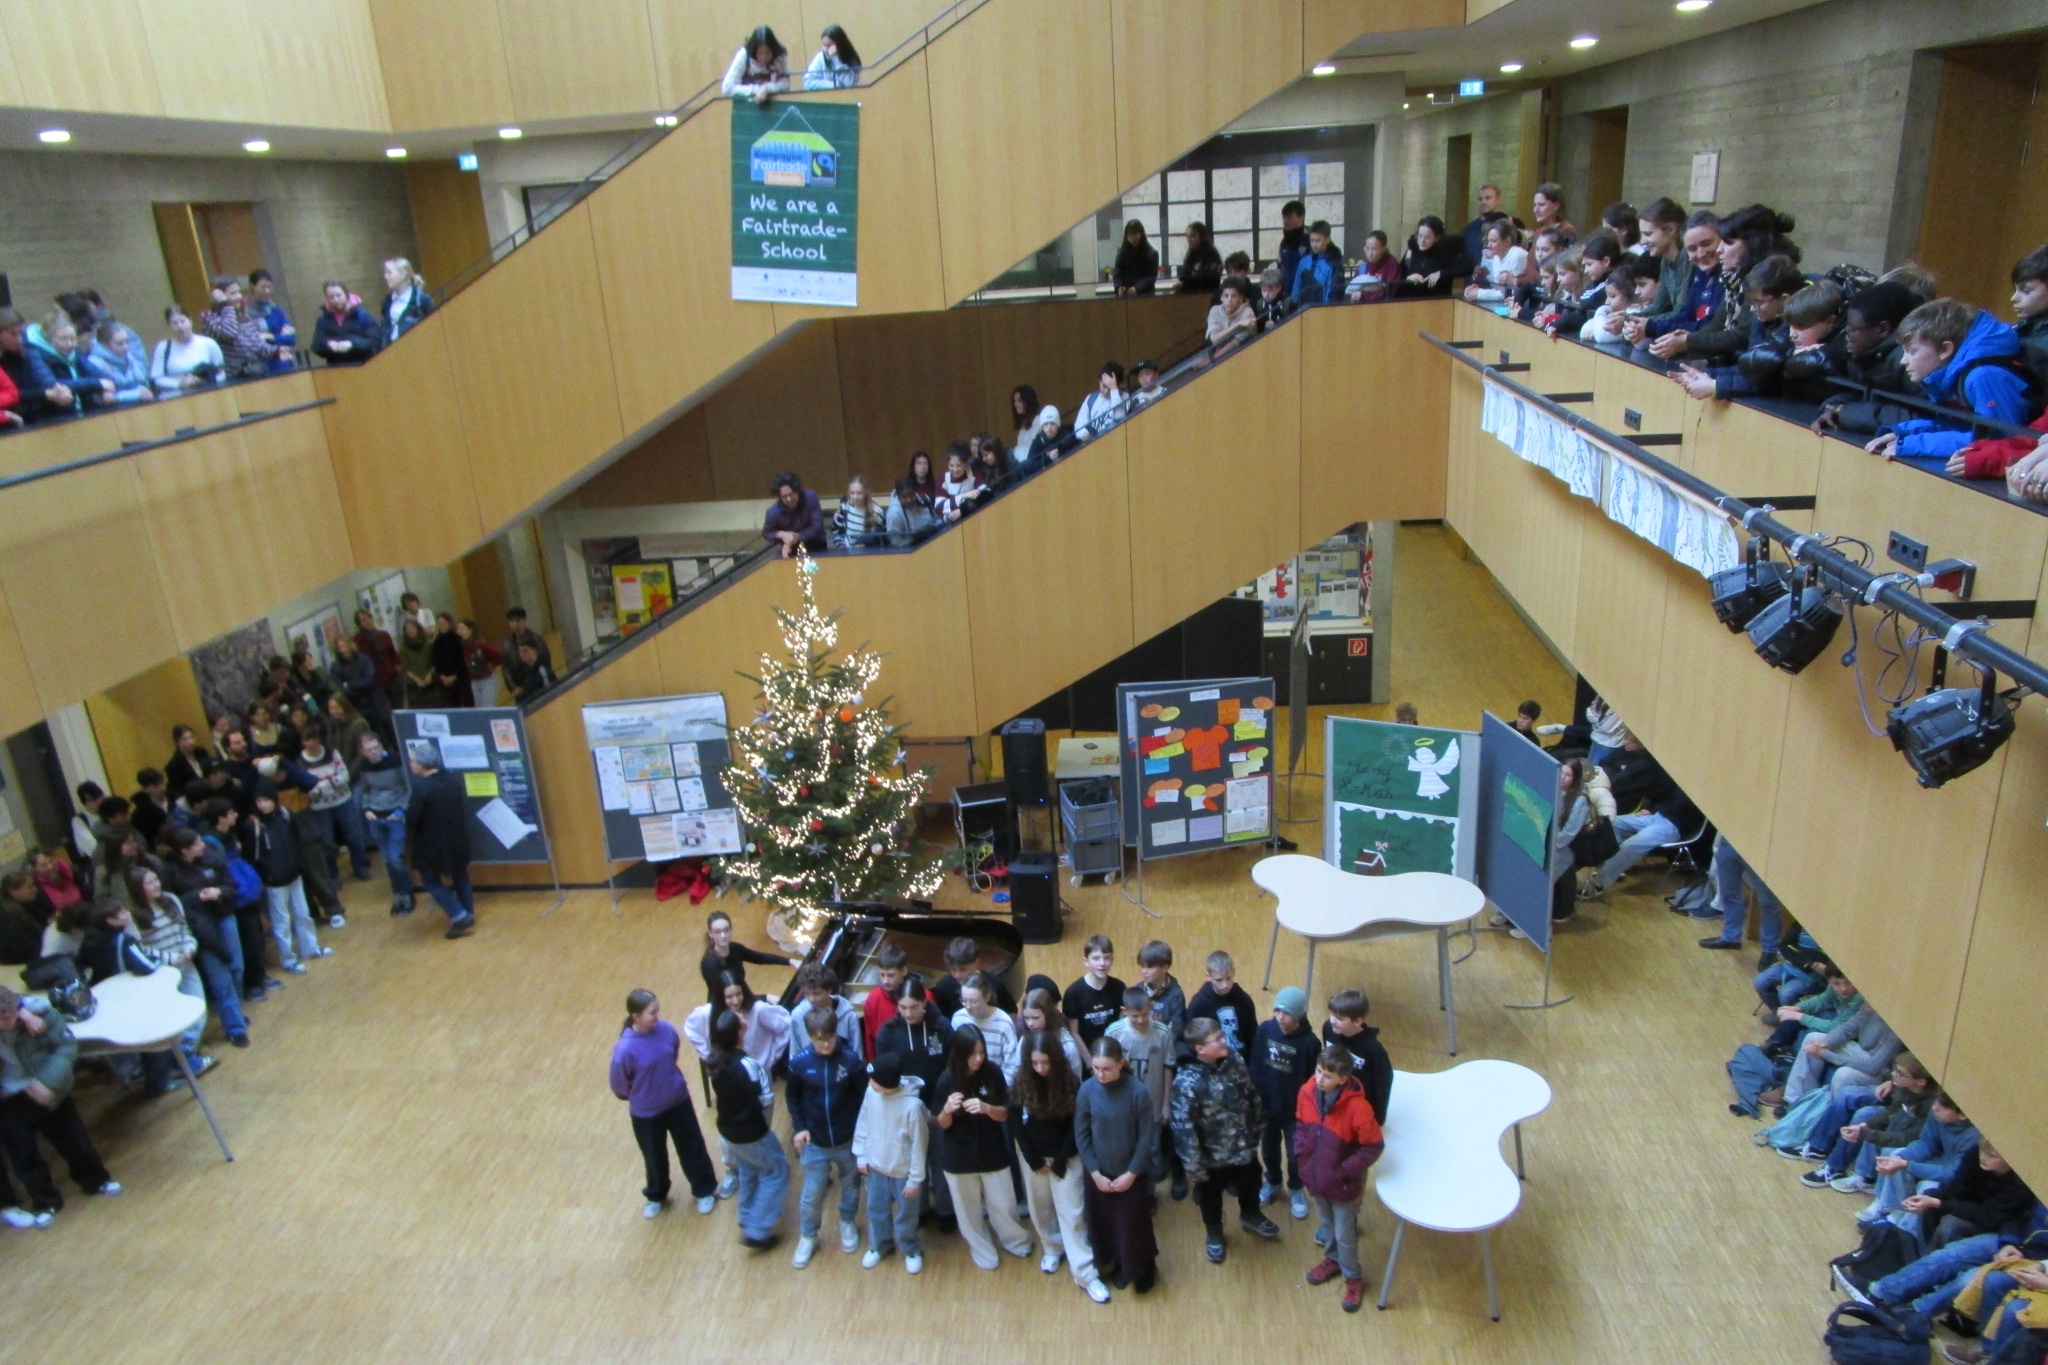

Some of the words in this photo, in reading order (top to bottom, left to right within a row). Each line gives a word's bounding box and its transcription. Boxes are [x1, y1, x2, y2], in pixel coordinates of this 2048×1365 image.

[754, 160, 807, 172] Fairtrade
[749, 193, 778, 211] We
[786, 199, 818, 214] are
[827, 202, 839, 215] a
[742, 217, 847, 238] Fairtrade-
[761, 240, 827, 261] School
